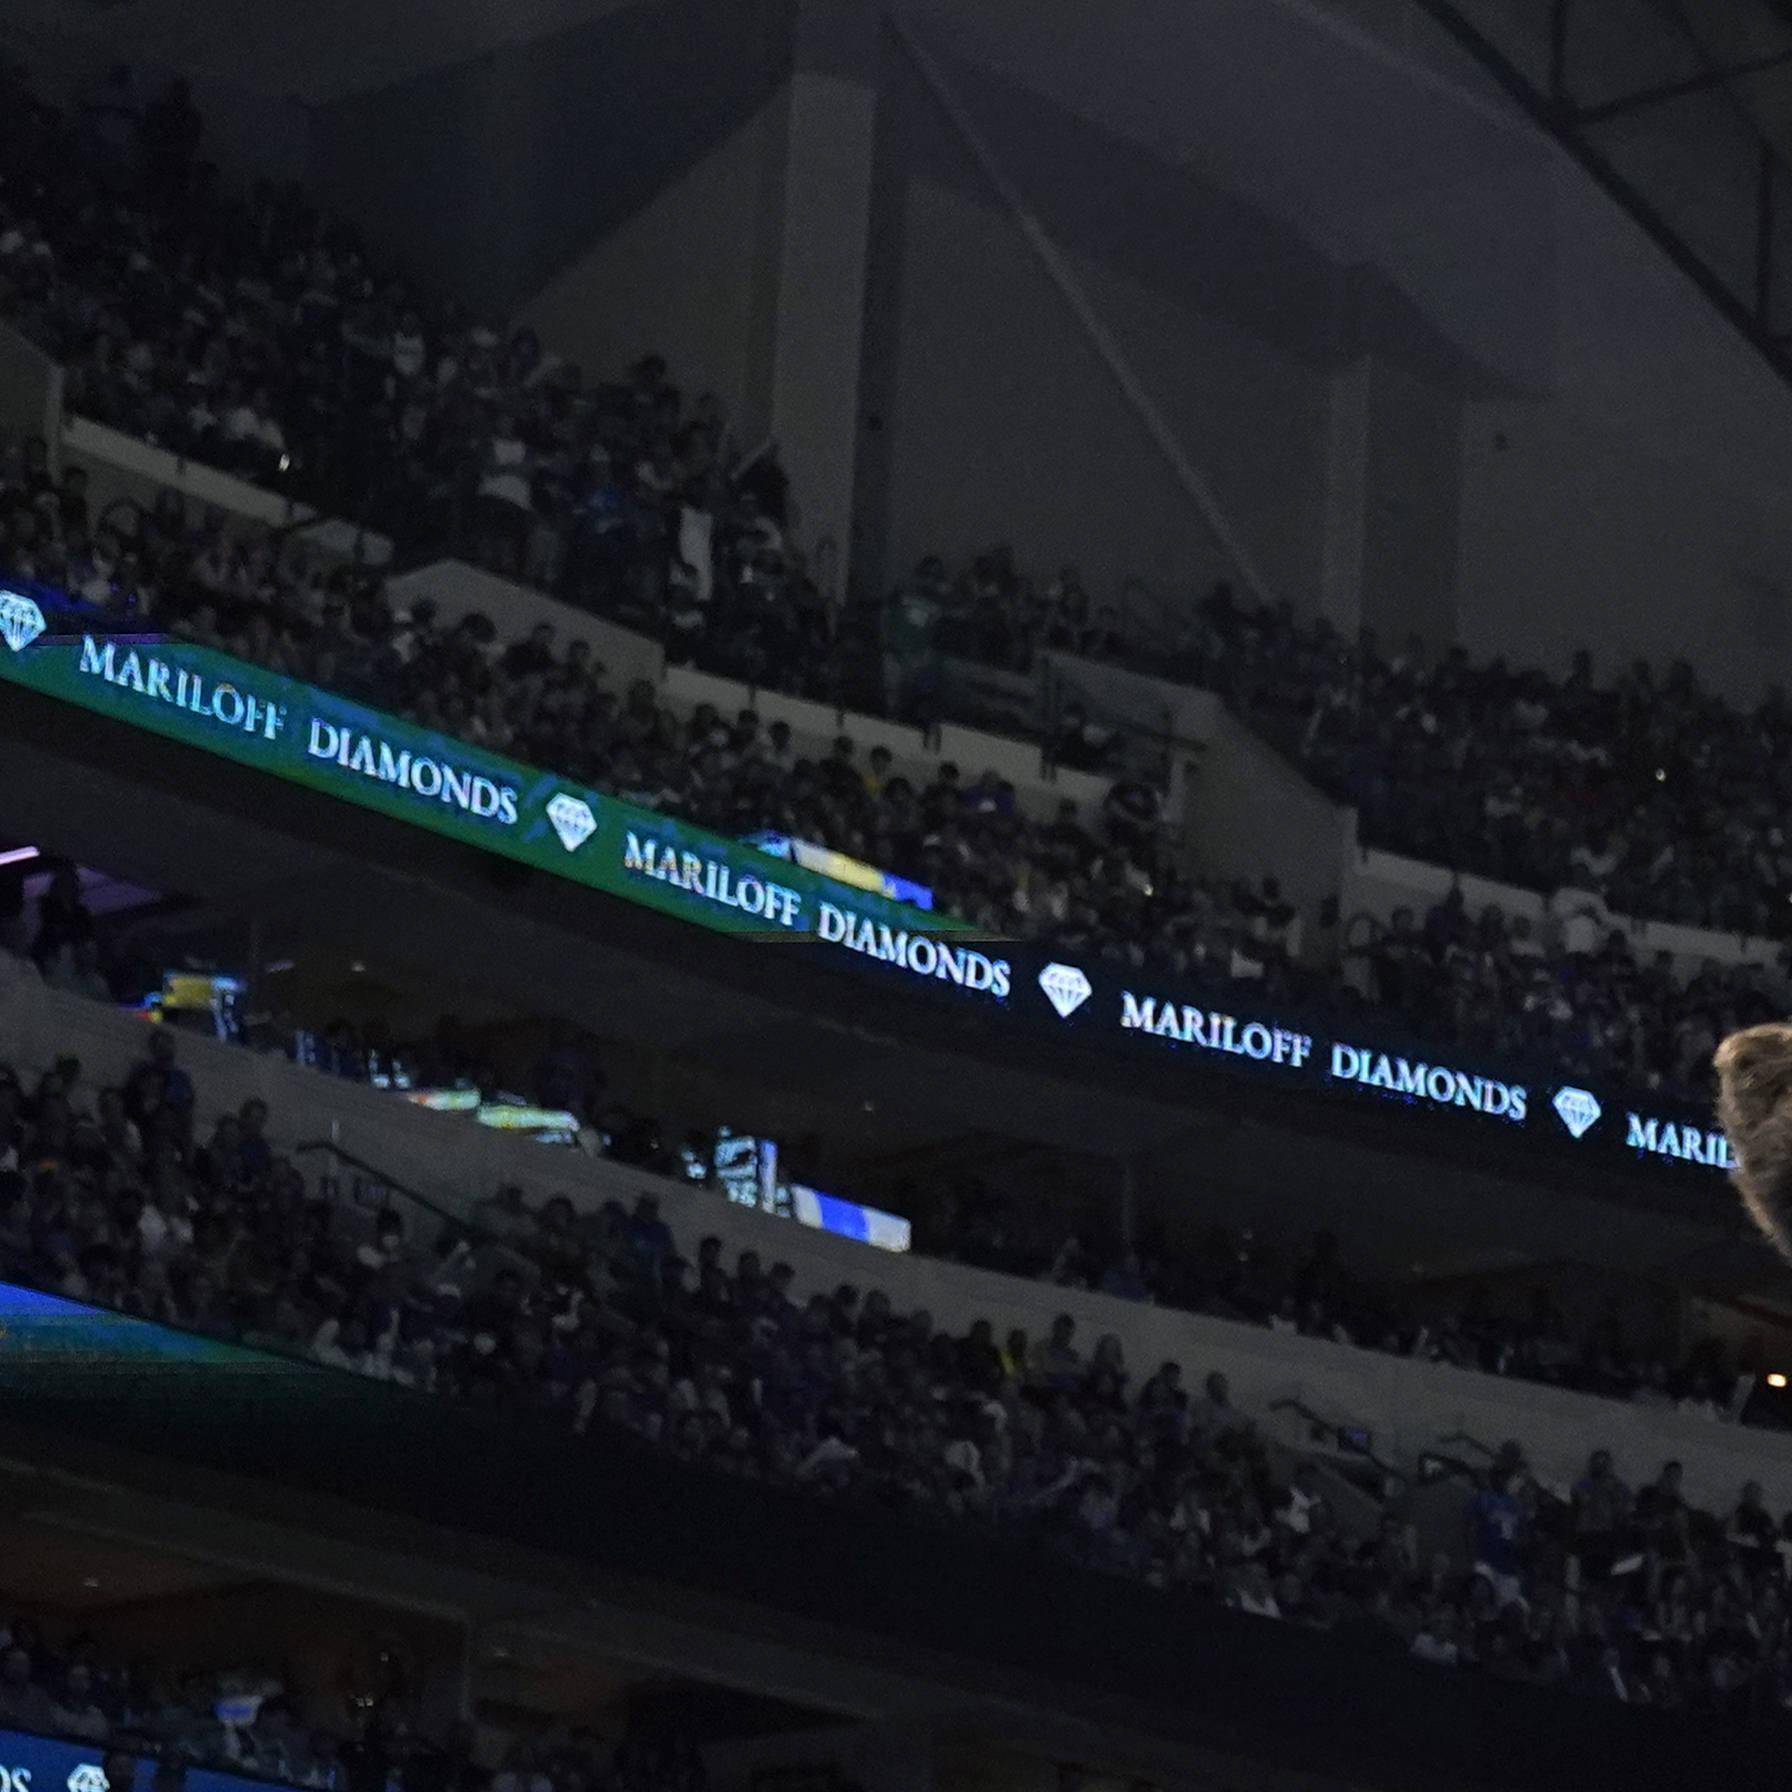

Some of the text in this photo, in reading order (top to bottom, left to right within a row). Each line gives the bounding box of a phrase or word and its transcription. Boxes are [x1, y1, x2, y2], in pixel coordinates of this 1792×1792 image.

[79, 635, 519, 825] MARILOFF DIAMONDS
[625, 832, 1011, 998] MARILOFF DIAMONDS
[1121, 990, 1527, 1121] MARILOFF DIAMONDS
